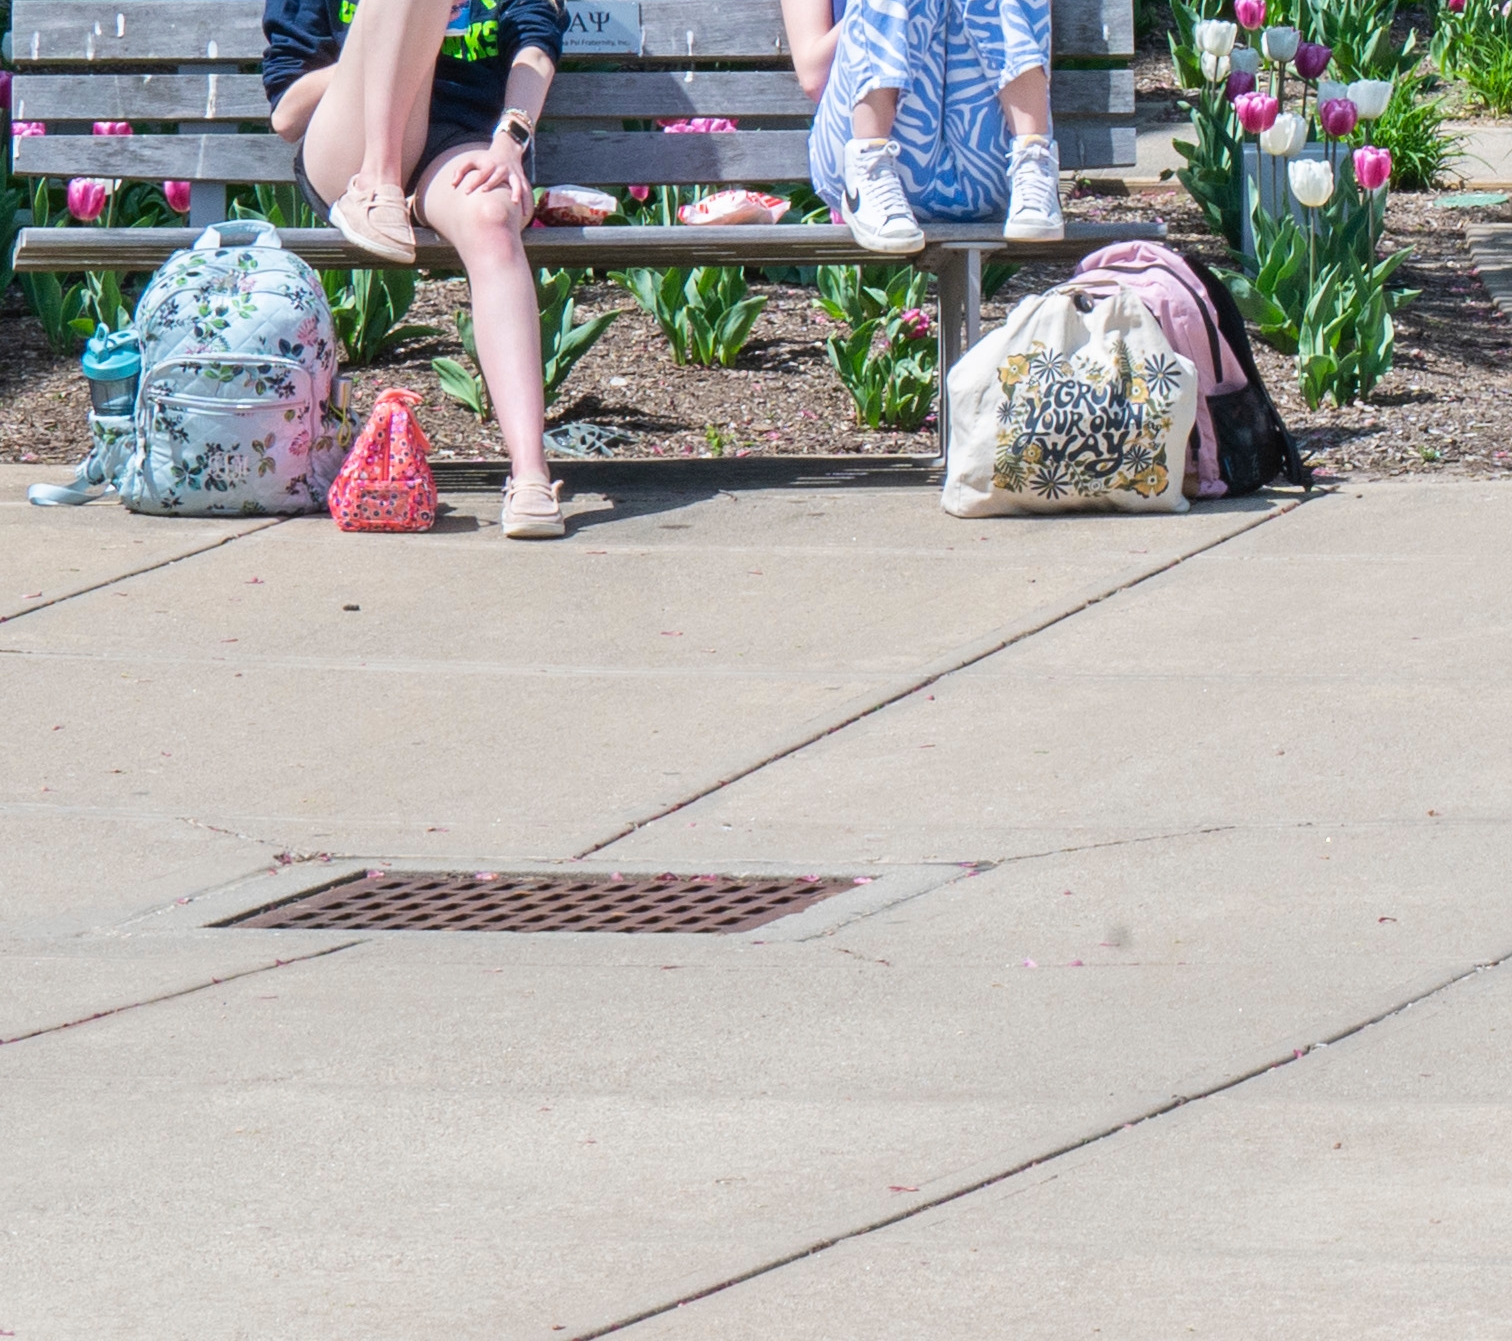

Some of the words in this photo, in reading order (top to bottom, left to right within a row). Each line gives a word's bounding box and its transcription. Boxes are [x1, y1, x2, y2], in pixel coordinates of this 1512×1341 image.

[1011, 397, 1088, 456] YOUR
[1089, 401, 1144, 436] OWN
[1035, 429, 1130, 479] WAY
